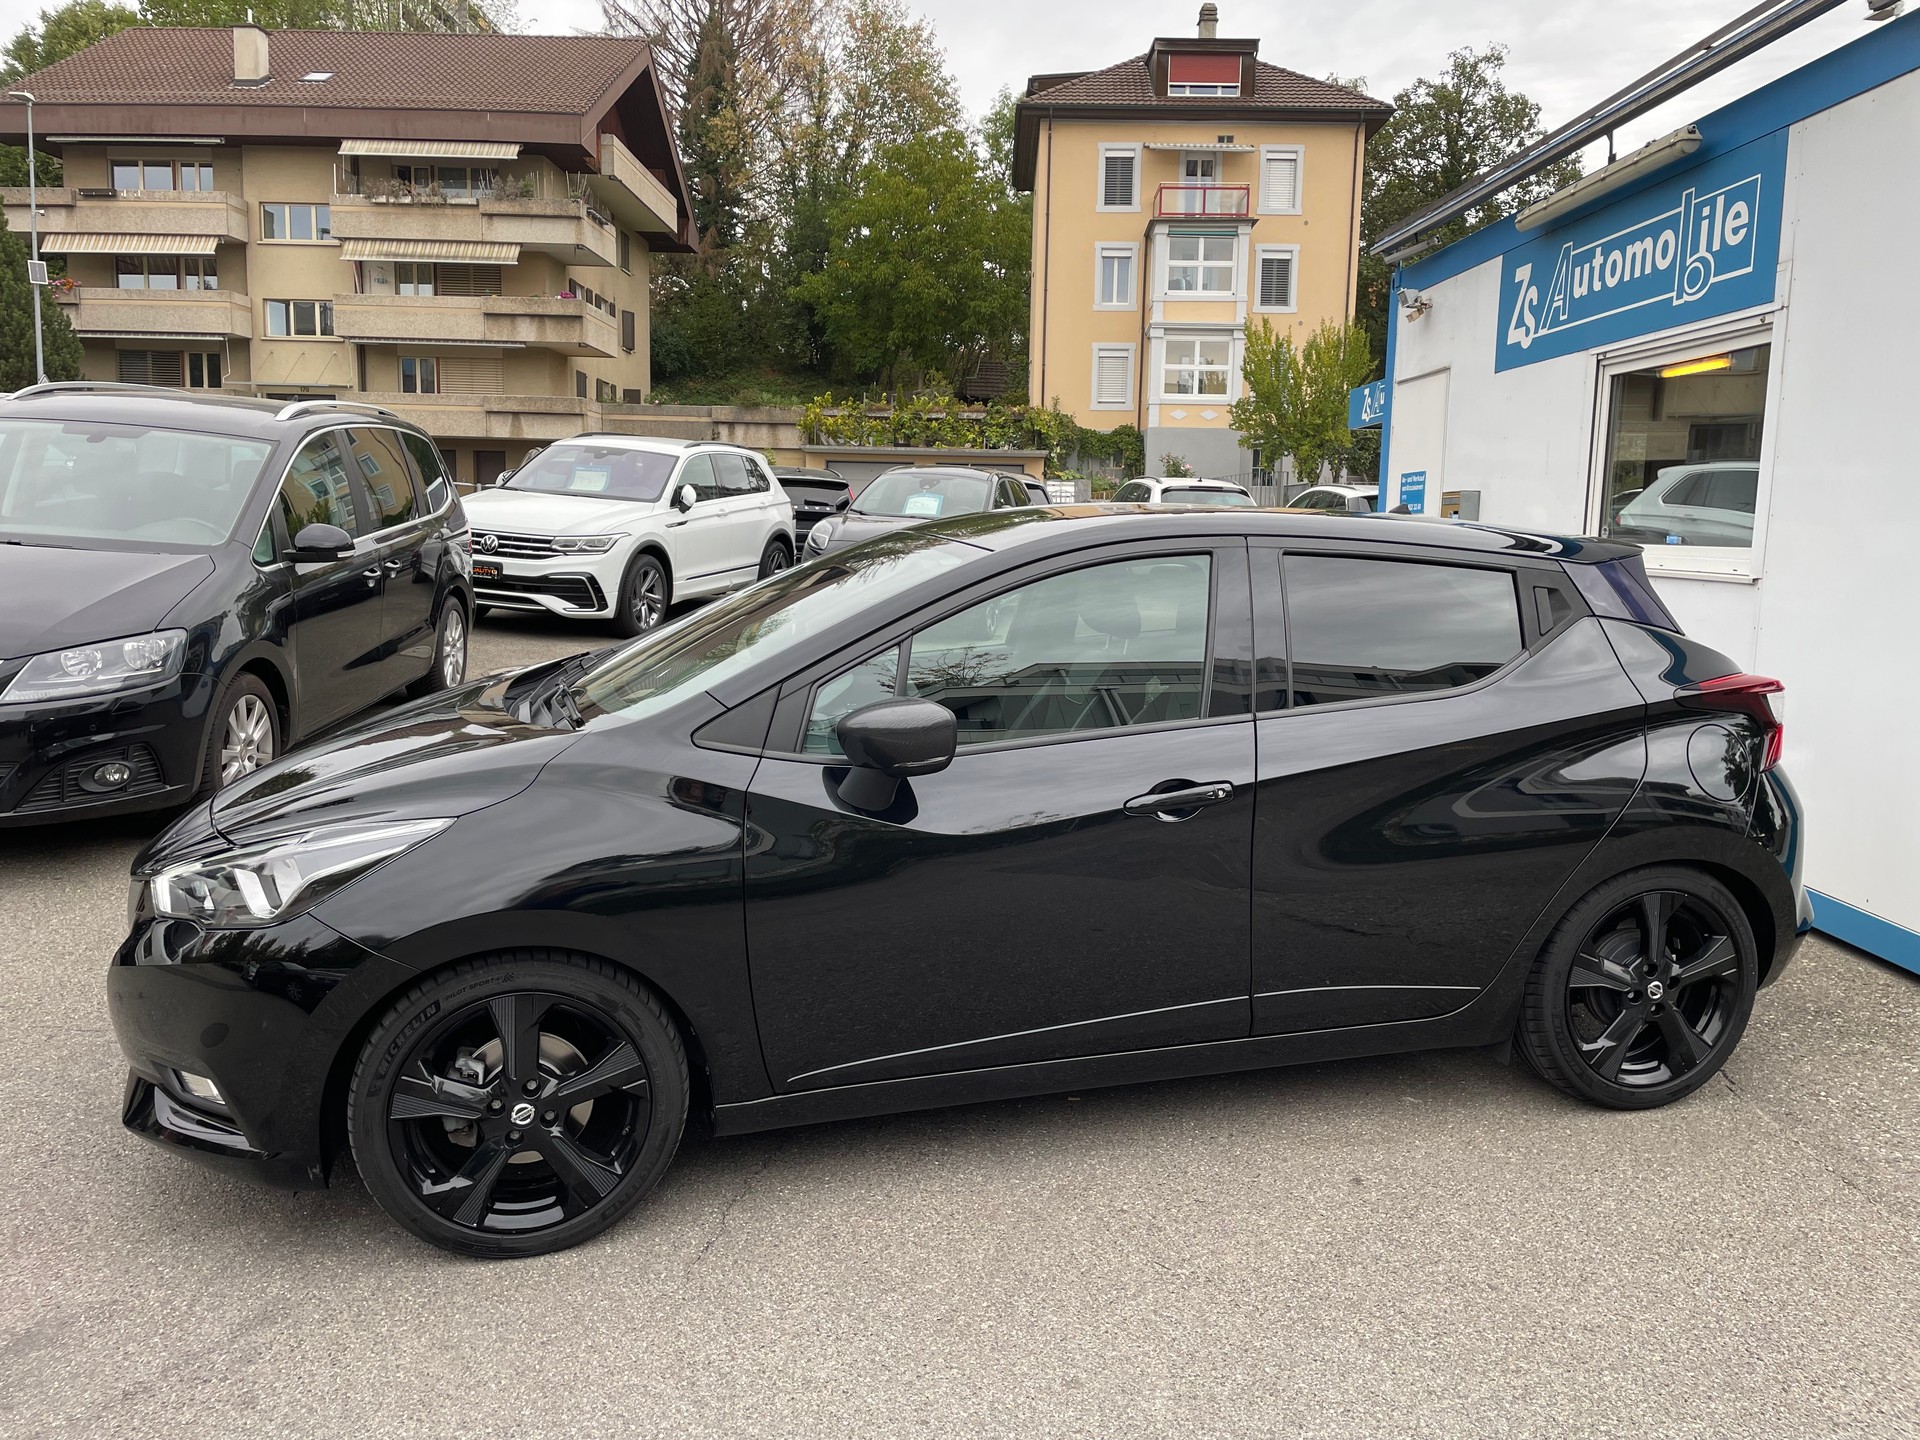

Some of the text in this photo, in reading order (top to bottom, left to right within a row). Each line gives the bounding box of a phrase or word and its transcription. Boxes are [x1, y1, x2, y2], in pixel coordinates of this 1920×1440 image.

[1539, 187, 1749, 334] Automobile
[445, 987, 467, 1001] PILOT
[469, 979, 495, 991] SPORT
[378, 1003, 437, 1075] MICHELIN
